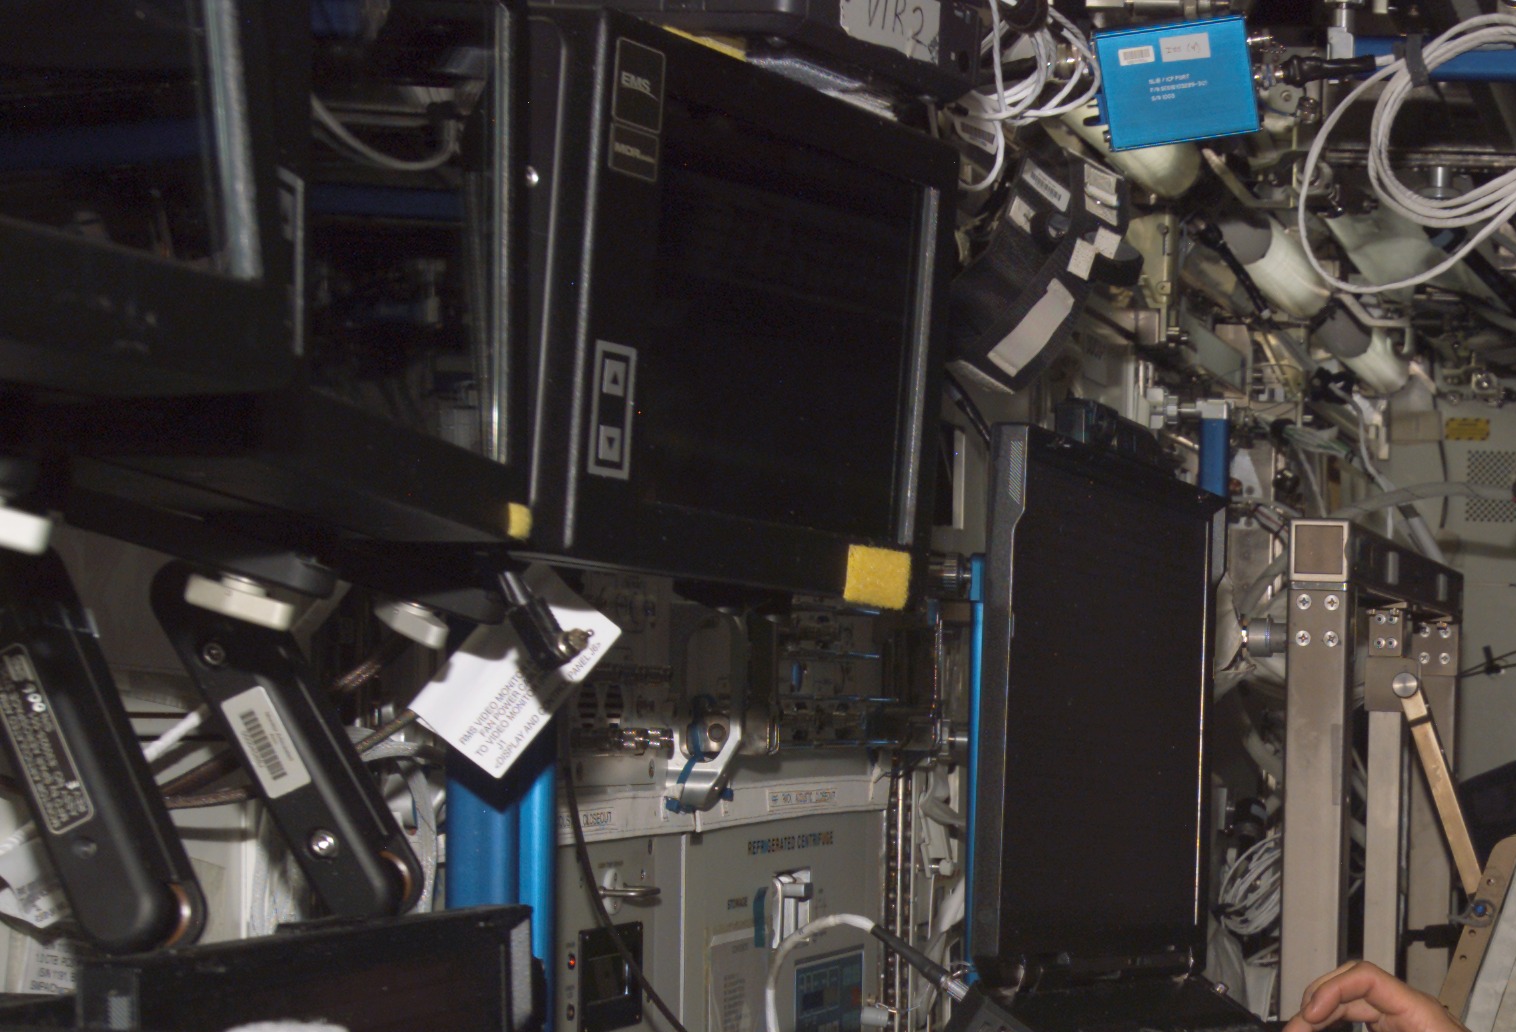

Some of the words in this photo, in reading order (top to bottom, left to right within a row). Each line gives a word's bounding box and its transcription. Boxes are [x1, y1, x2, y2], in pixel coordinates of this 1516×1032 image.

[911, 5, 931, 50] 2
[480, 718, 494, 737] FAN
[493, 690, 521, 720] POWER
[524, 713, 540, 735] AND
[567, 654, 591, 680] PANEL
[459, 727, 478, 745] RMS
[474, 701, 498, 727] VIDEO
[474, 743, 489, 757] TO
[486, 720, 509, 745] VIDEO
[747, 836, 795, 856] REFRIGERATED
[797, 830, 834, 850] CENTRIFUGE
